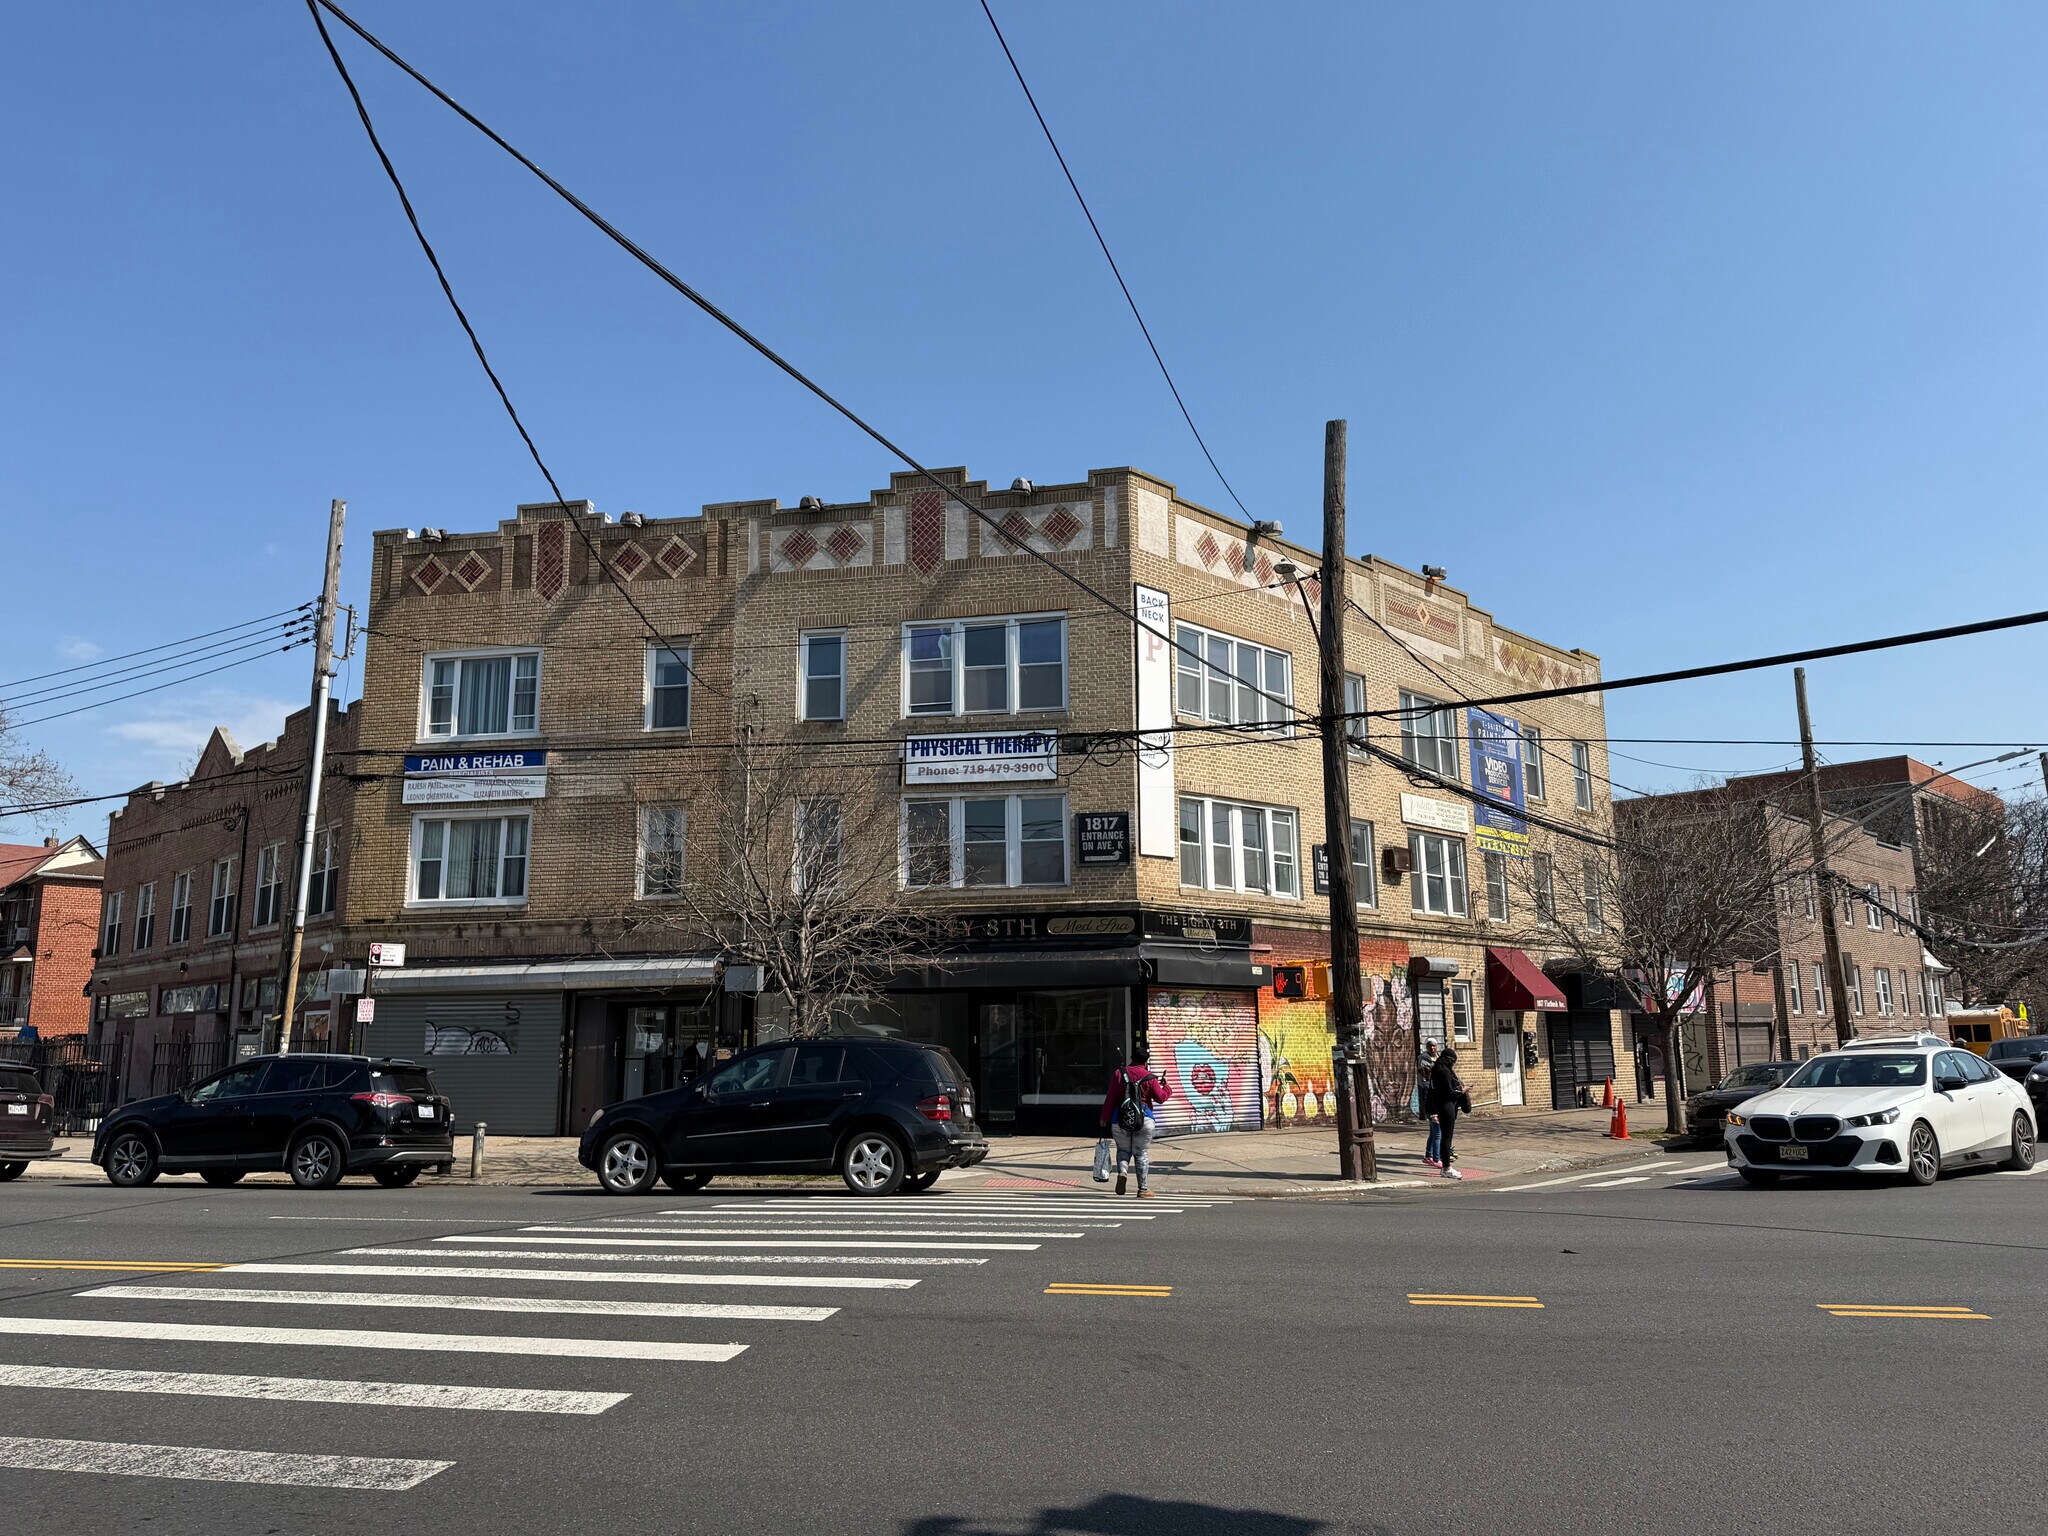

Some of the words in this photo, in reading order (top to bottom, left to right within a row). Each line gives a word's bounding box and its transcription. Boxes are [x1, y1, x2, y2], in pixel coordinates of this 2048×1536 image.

[1141, 594, 1164, 609] BACK
[1141, 608, 1165, 623] NECK
[911, 738, 982, 757] PHYSICAL
[983, 734, 1051, 755] THERAPY
[420, 757, 455, 771] PAIN
[458, 756, 469, 769] &
[472, 754, 524, 768] REHAB
[917, 766, 959, 776] Phone:
[962, 762, 1045, 775] 718-479-3900
[1484, 756, 1508, 774] VIDEO
[1085, 816, 1119, 830] 1817
[1081, 830, 1124, 841] ENTRANCE
[1082, 841, 1094, 850] ON
[1097, 841, 1115, 850] AVE.
[1117, 840, 1124, 850] K
[986, 918, 1037, 937] 8TH
[1052, 919, 1092, 934] Med
[1096, 917, 1130, 933] Spa
[1159, 914, 1179, 926] THE
[1216, 919, 1237, 930] 8TH
